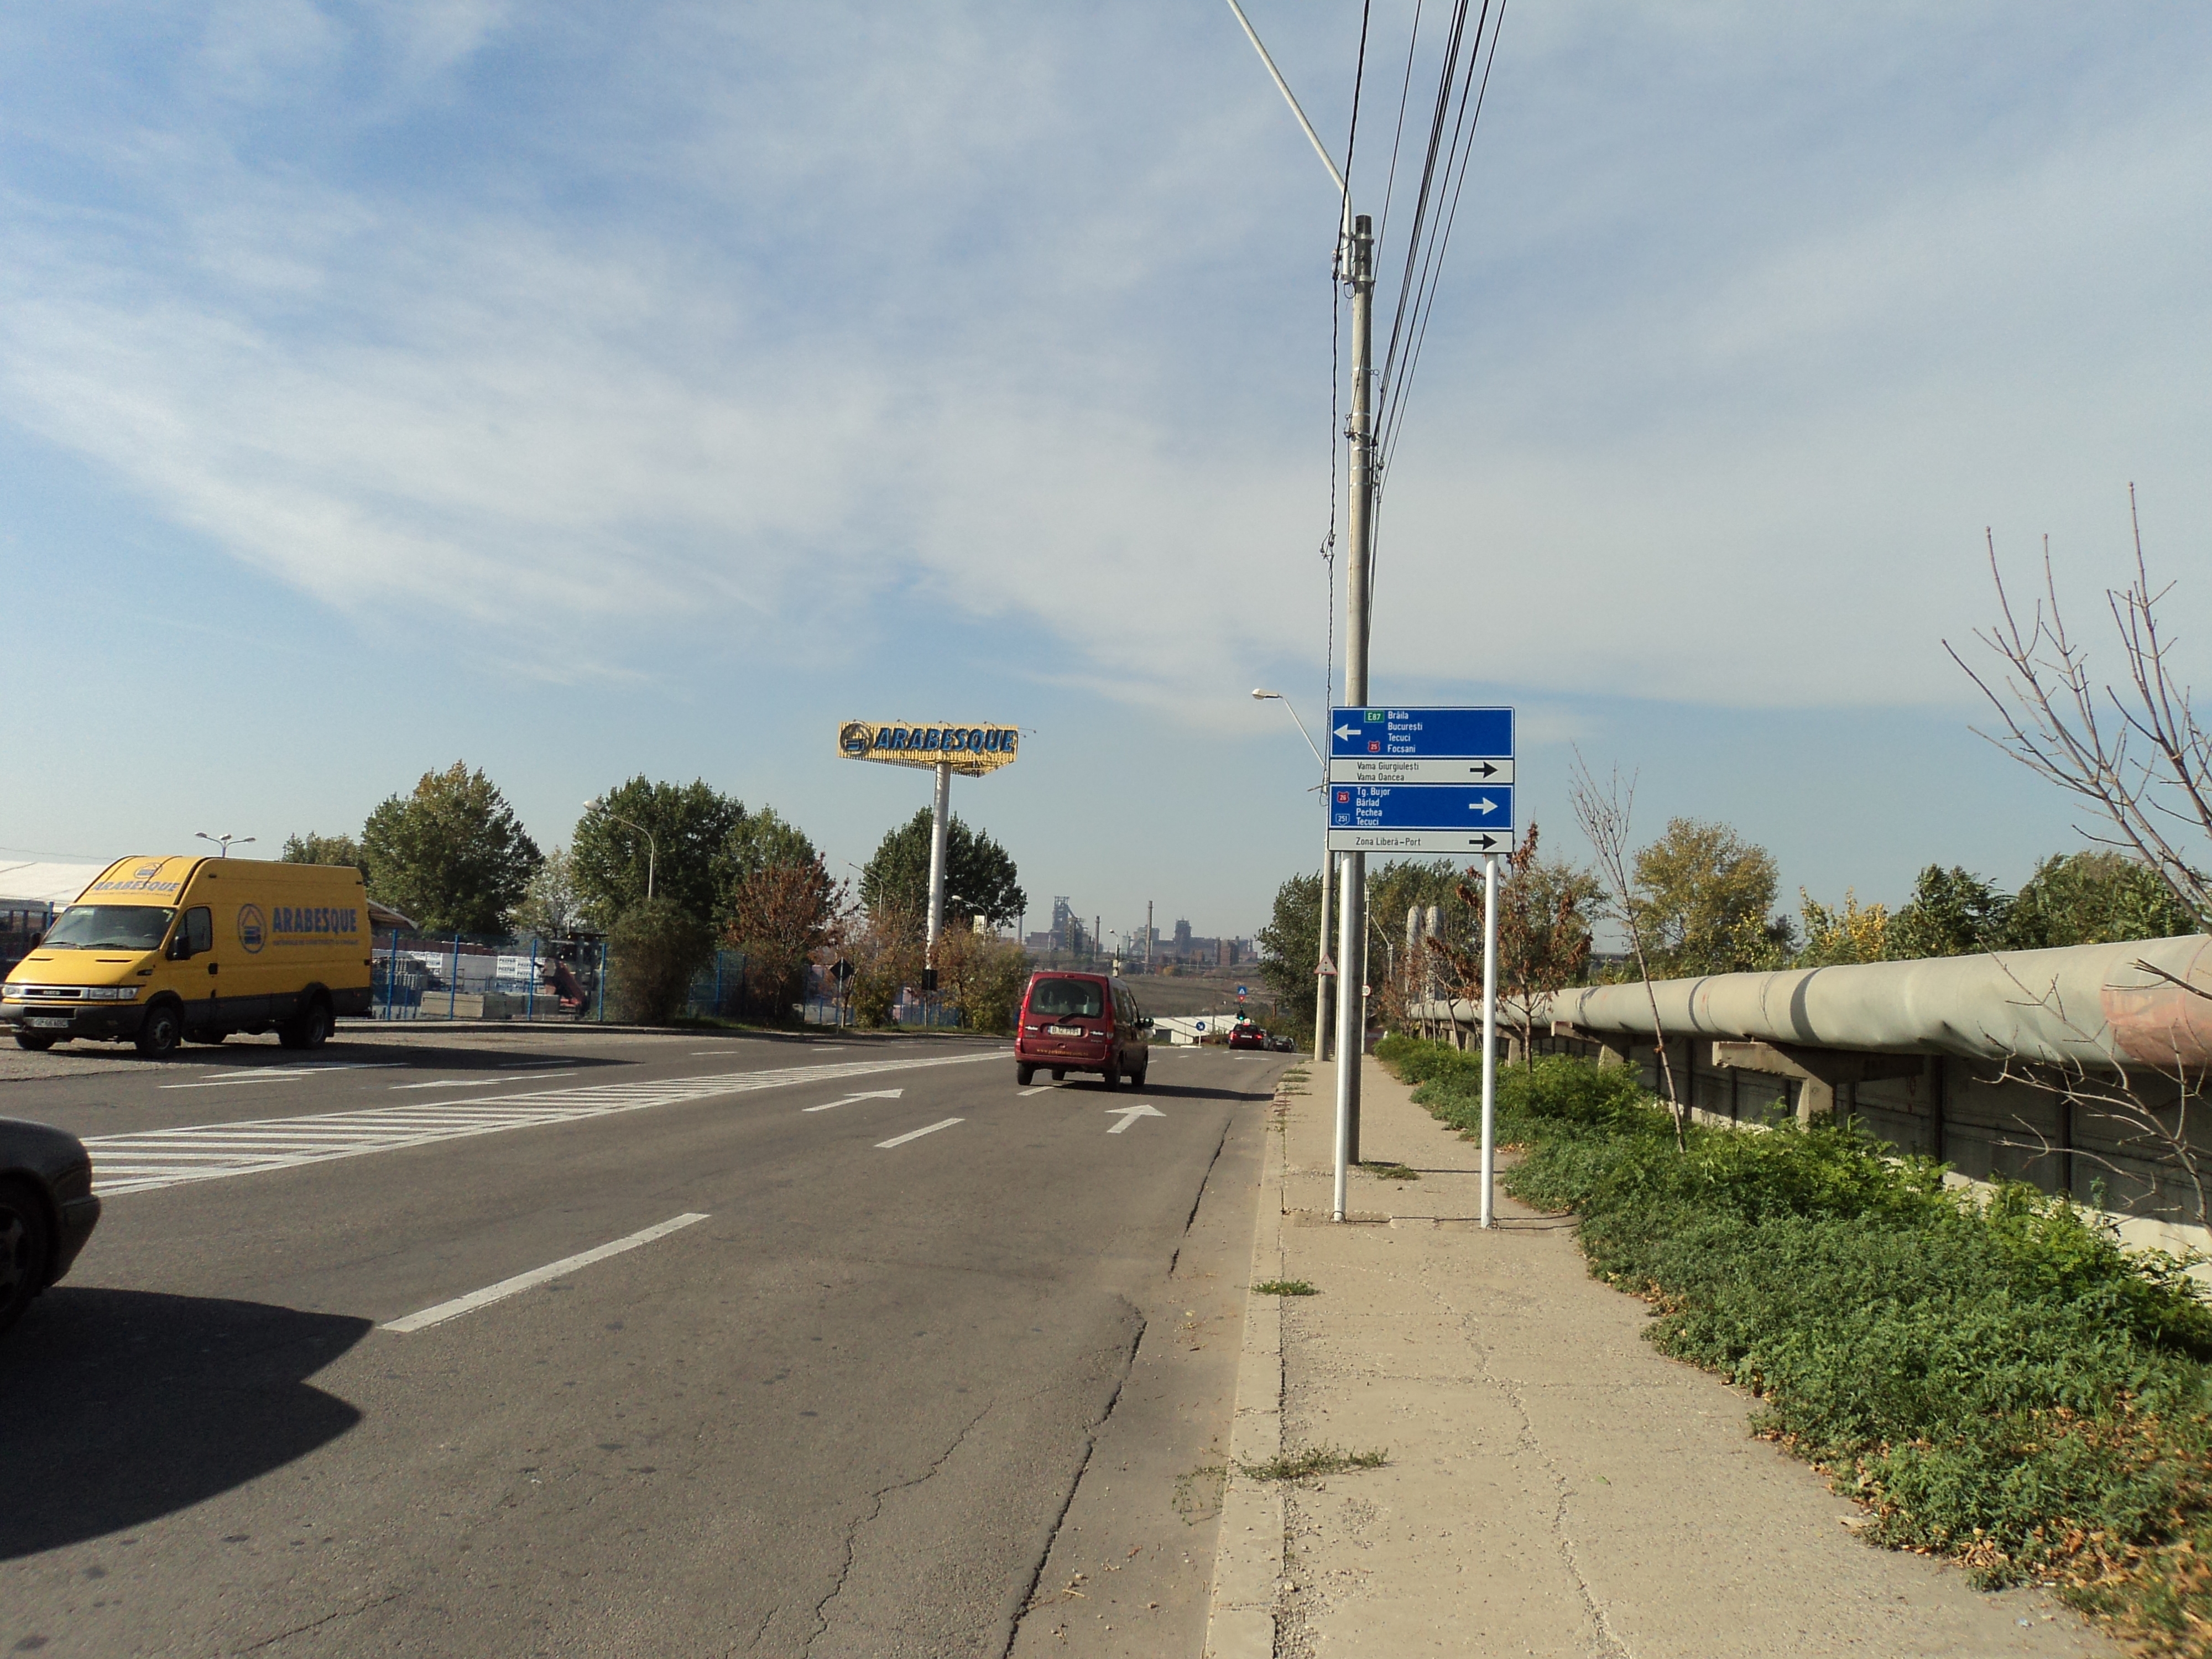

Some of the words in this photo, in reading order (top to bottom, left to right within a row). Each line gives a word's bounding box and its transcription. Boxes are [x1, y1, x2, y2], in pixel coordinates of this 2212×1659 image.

[1368, 712, 1381, 721] E87
[874, 727, 1016, 754] ARABESQUE
[1388, 733, 1411, 742] Tecuci
[1357, 761, 1376, 770] Vama
[1357, 773, 1375, 781] Vama
[1378, 773, 1405, 781] Oancea
[1357, 787, 1369, 797] Tg.
[1371, 787, 1391, 797] Bujor
[1356, 808, 1383, 816] Pechea
[1357, 817, 1379, 826] Tecuci
[1356, 837, 1374, 846] Zona
[92, 881, 180, 891] ARABESQUE
[272, 907, 357, 934] ARABESQUE
